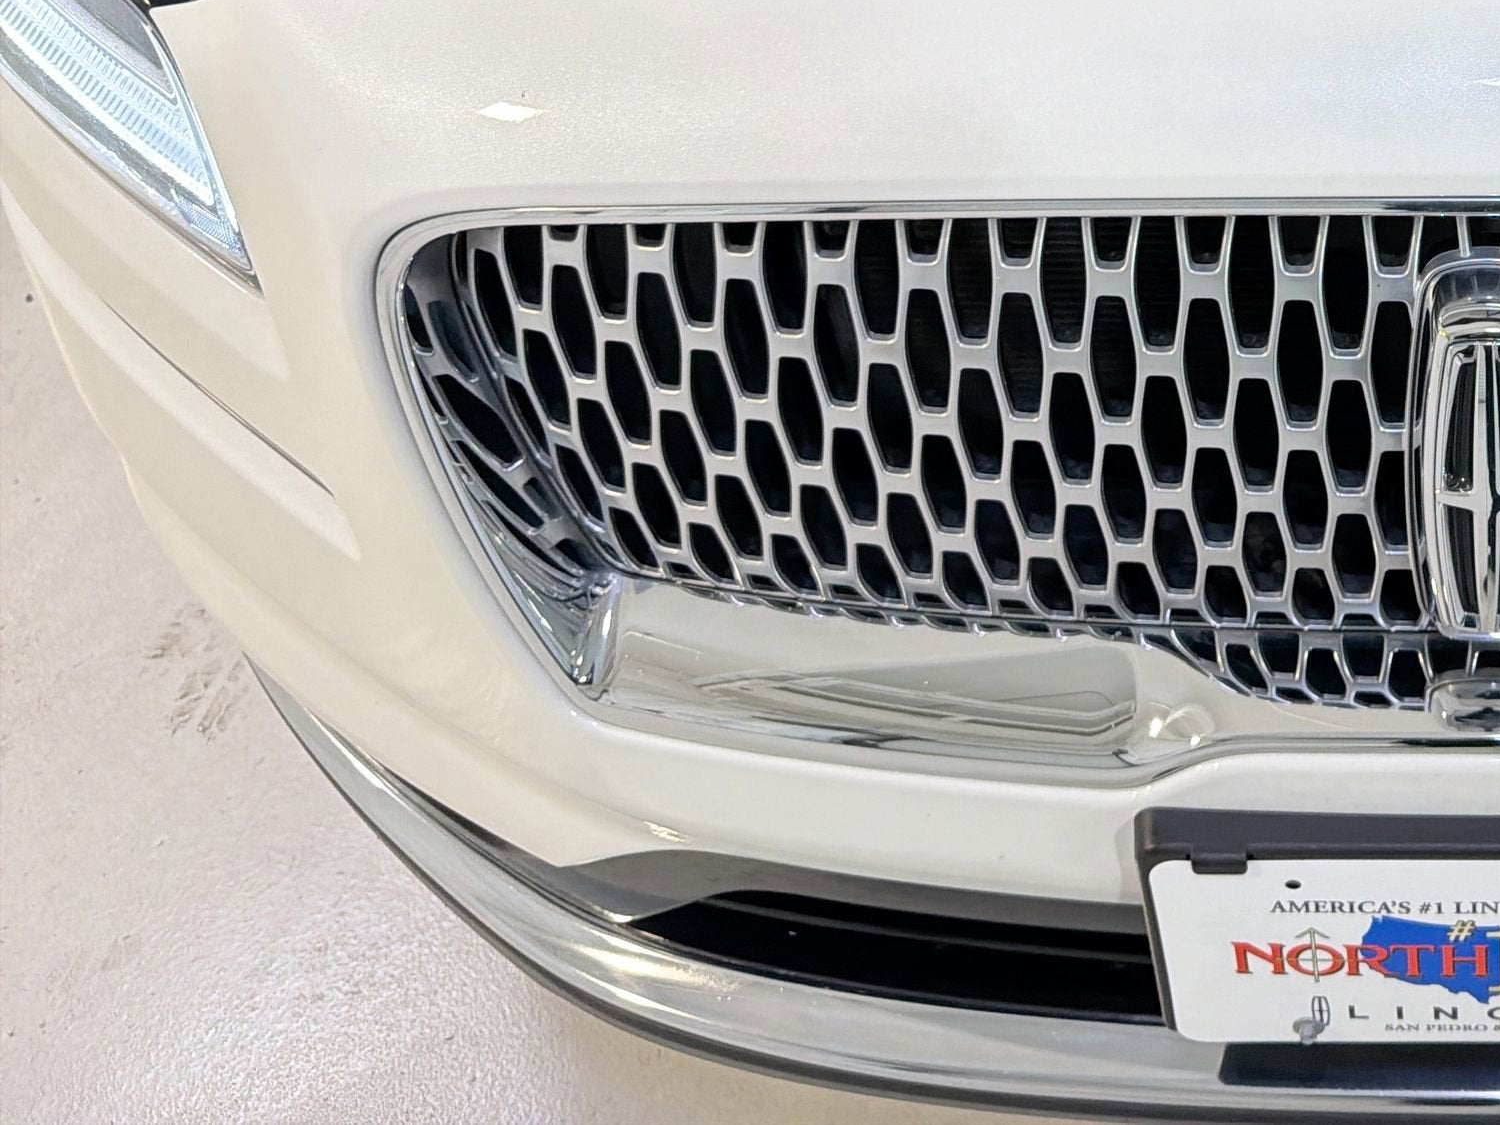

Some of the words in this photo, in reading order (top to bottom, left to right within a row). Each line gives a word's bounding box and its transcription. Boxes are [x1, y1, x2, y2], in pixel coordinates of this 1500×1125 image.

[1269, 900, 1412, 915] AMERICA'S
[1418, 901, 1444, 915] #1
[1231, 941, 1490, 978] NORTH
[1385, 1024, 1420, 1032] SAN
[1426, 1024, 1488, 1032] PEDRO
